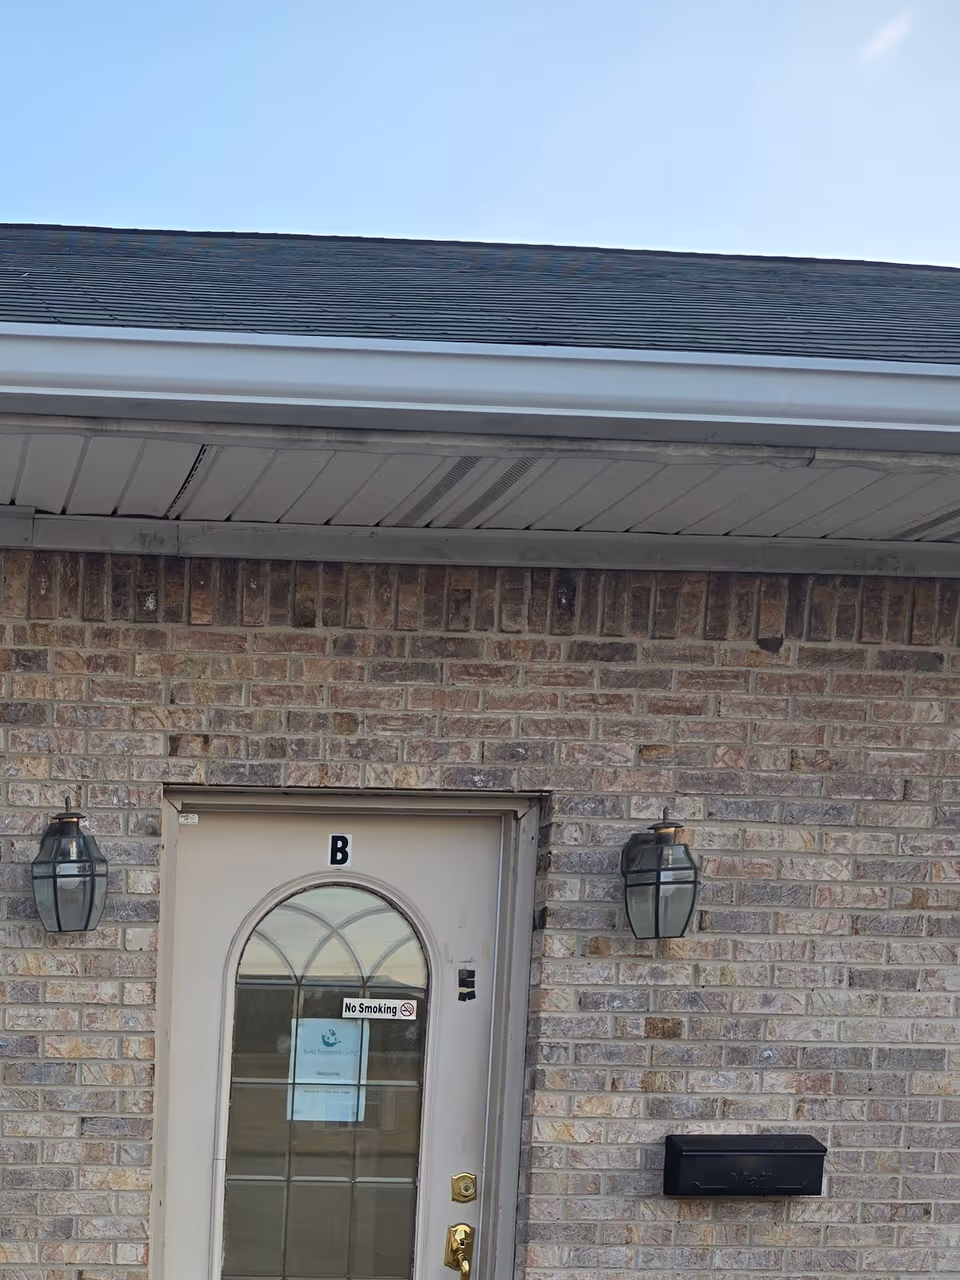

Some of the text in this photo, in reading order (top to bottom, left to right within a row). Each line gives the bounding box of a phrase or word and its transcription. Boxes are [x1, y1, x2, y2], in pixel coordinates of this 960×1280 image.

[329, 835, 349, 866] B
[344, 1002, 398, 1017] No Smoking
